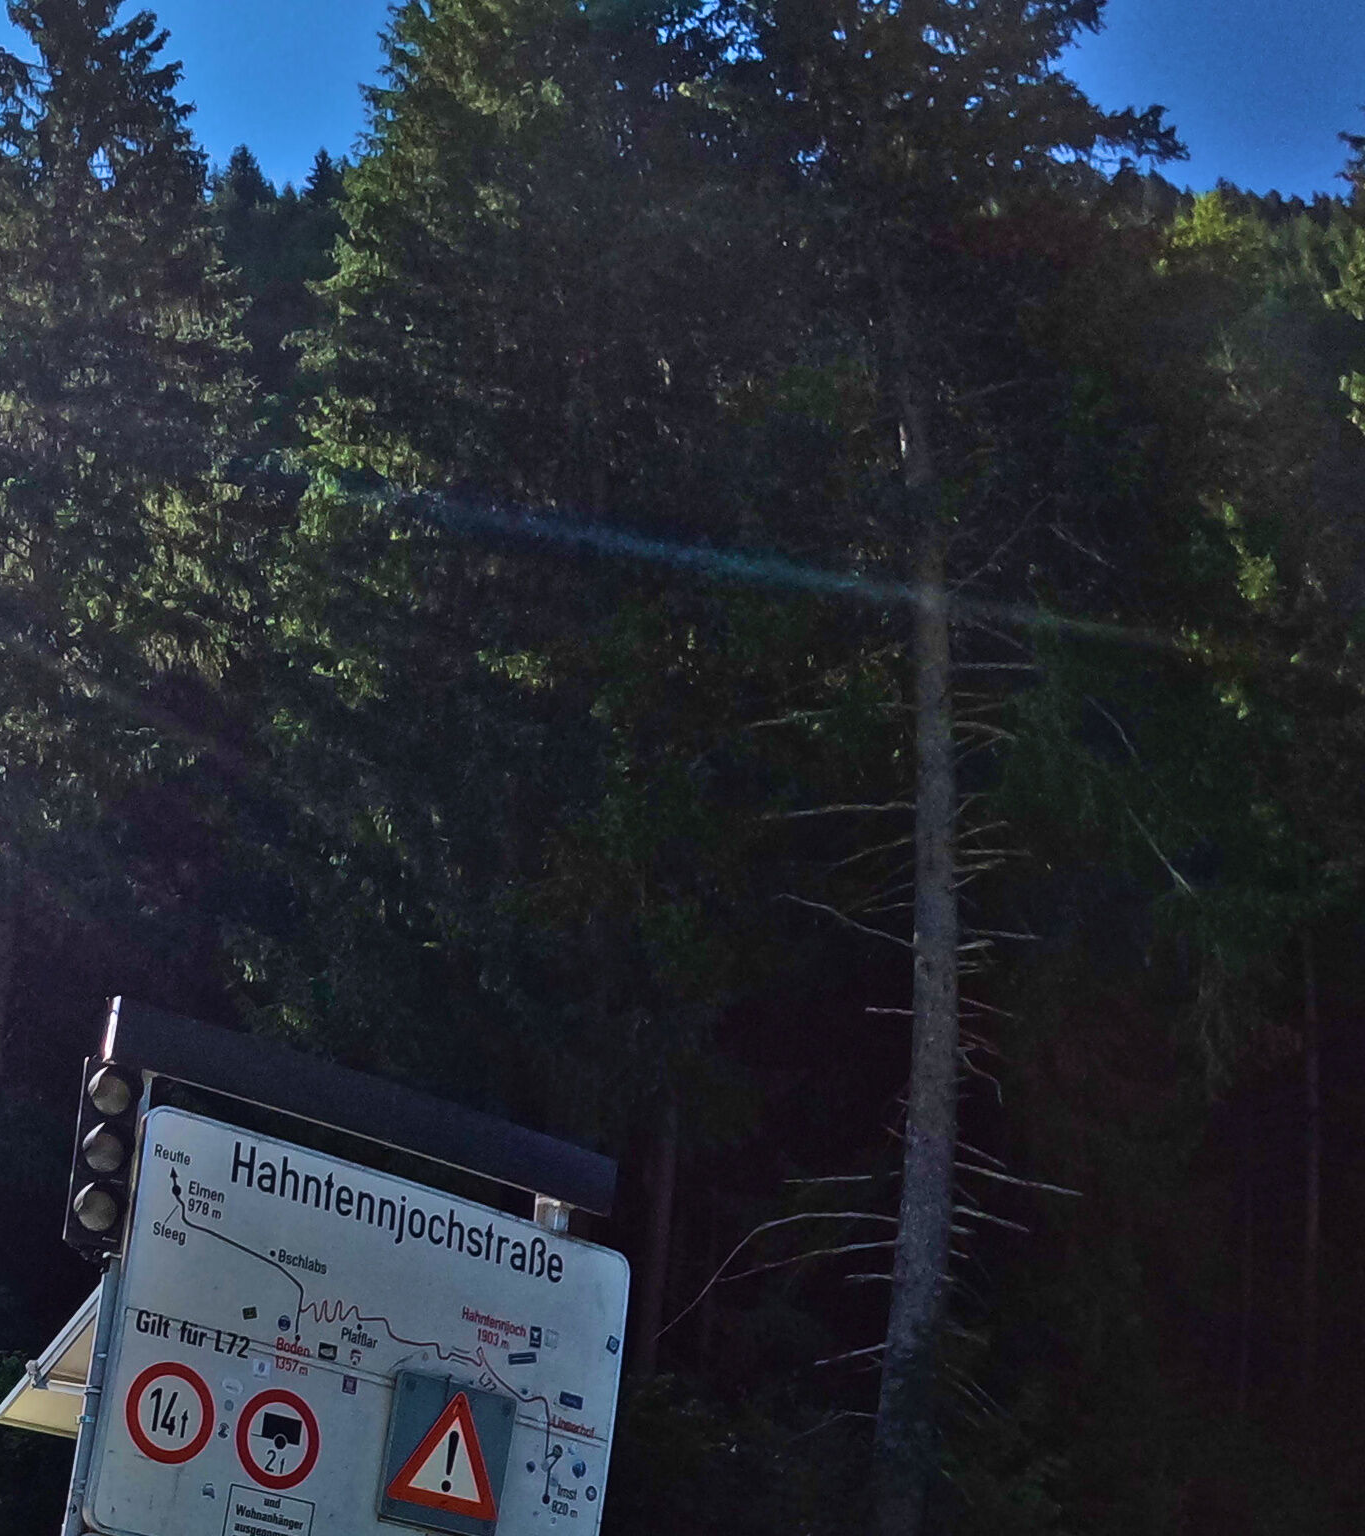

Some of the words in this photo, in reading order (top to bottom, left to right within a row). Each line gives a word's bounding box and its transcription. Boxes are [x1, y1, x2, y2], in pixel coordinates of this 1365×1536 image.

[153, 1143, 191, 1166] Reutte
[188, 1180, 225, 1203] Elmen
[187, 1199, 209, 1216] 978
[230, 1142, 564, 1283] Hahntennjochstraße
[153, 1221, 187, 1245] Steeg
[278, 1249, 328, 1275] Bschlabs
[461, 1306, 527, 1337] Hahntennjoch
[135, 1310, 171, 1339] Gilt
[179, 1319, 207, 1348] für
[214, 1329, 251, 1359] L72
[477, 1328, 500, 1346] 1903
[276, 1337, 311, 1357] Boden
[275, 1355, 299, 1373] 1357
[264, 1497, 282, 1509] und
[557, 1484, 578, 1500] Imst
[235, 1503, 304, 1531] Wohnanhänger
[551, 1500, 569, 1516] 820
